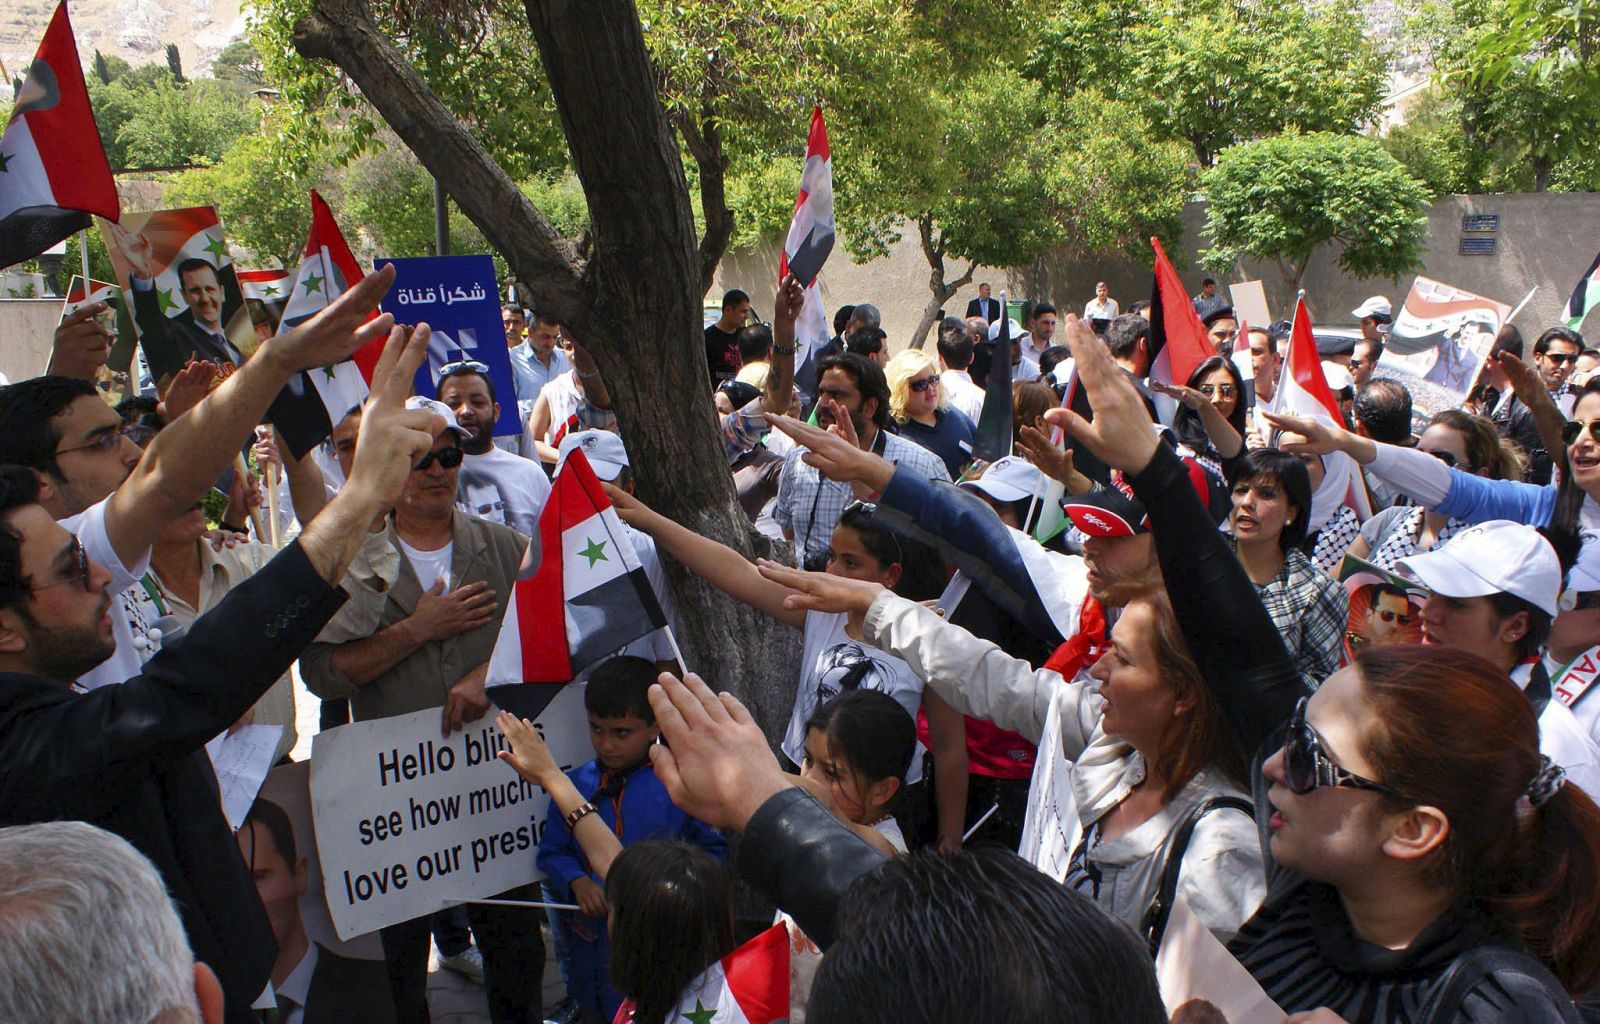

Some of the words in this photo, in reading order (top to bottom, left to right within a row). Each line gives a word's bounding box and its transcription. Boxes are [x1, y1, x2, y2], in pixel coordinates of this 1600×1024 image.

[398, 287, 437, 305] قناة
[378, 740, 455, 787] Hello
[358, 811, 403, 845] see
[409, 794, 461, 831] how
[469, 773, 532, 815] much
[344, 863, 408, 905] love
[416, 845, 463, 881] our
